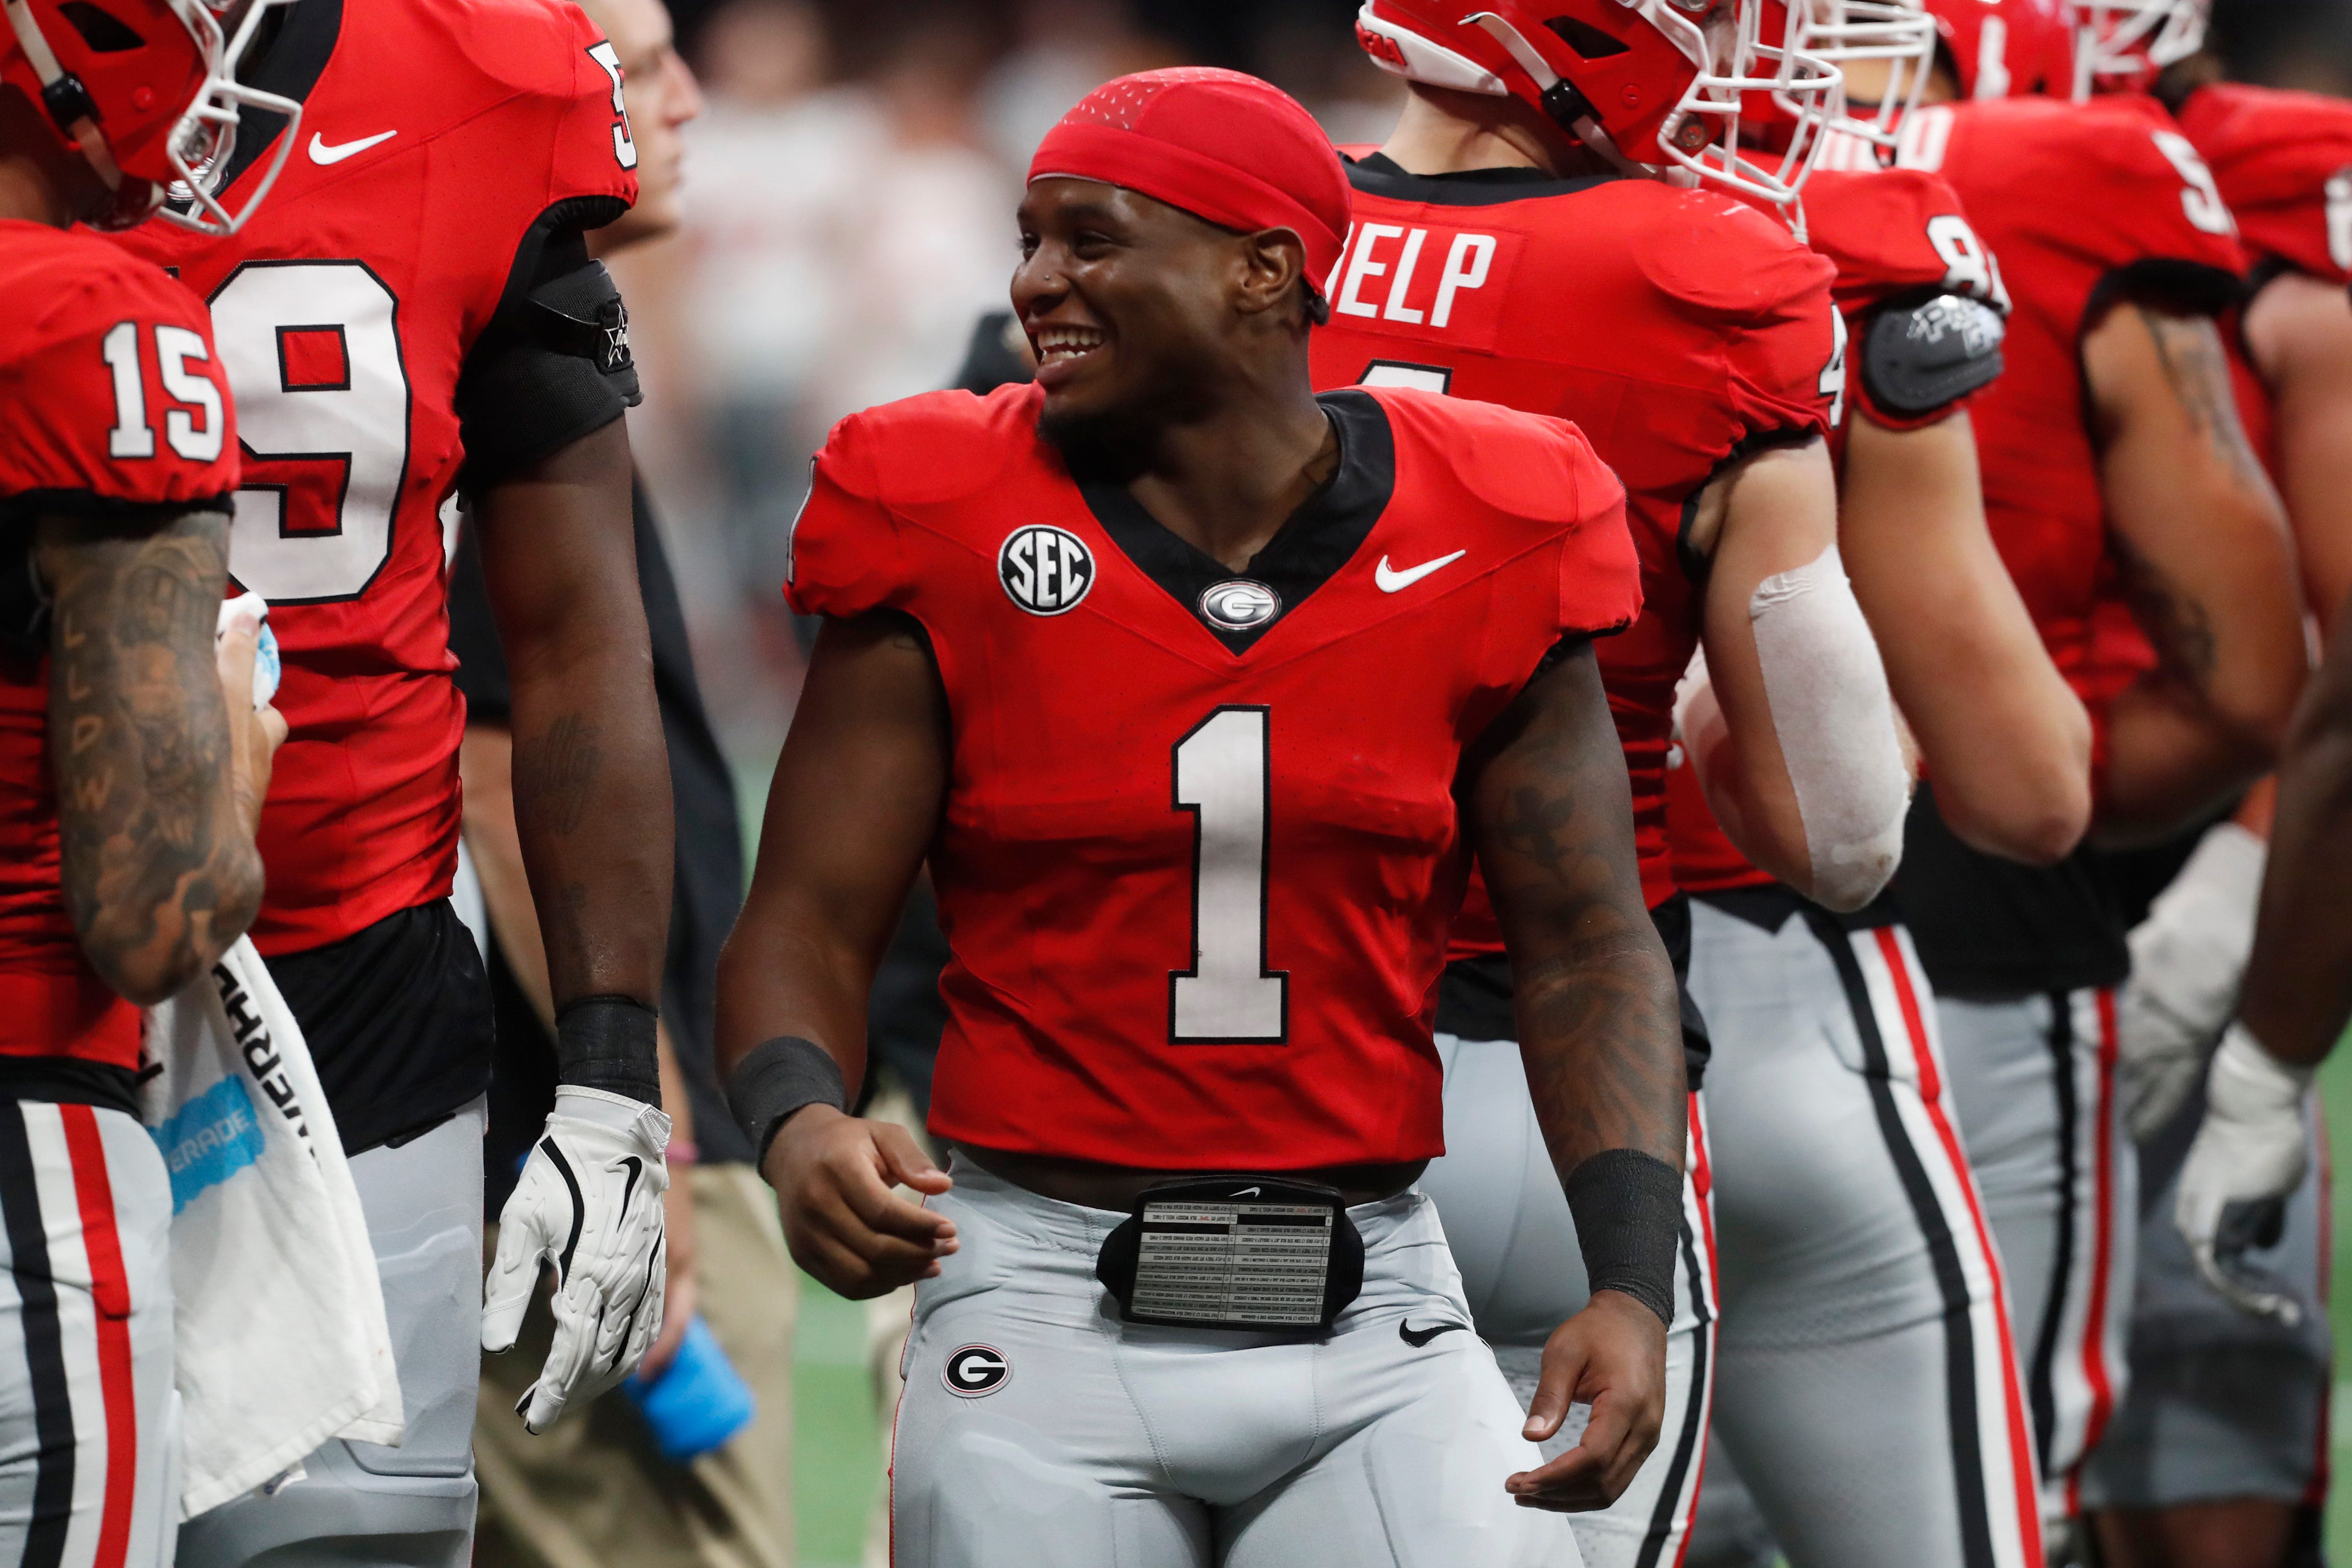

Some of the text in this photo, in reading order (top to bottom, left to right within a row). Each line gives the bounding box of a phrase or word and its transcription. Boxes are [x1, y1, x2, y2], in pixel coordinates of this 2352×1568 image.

[103, 320, 225, 462] 15
[164, 258, 412, 606] 9
[1007, 530, 1085, 607] SEC
[1204, 585, 1275, 623] G
[1168, 704, 1289, 1045] 1
[947, 1348, 1006, 1390] G
